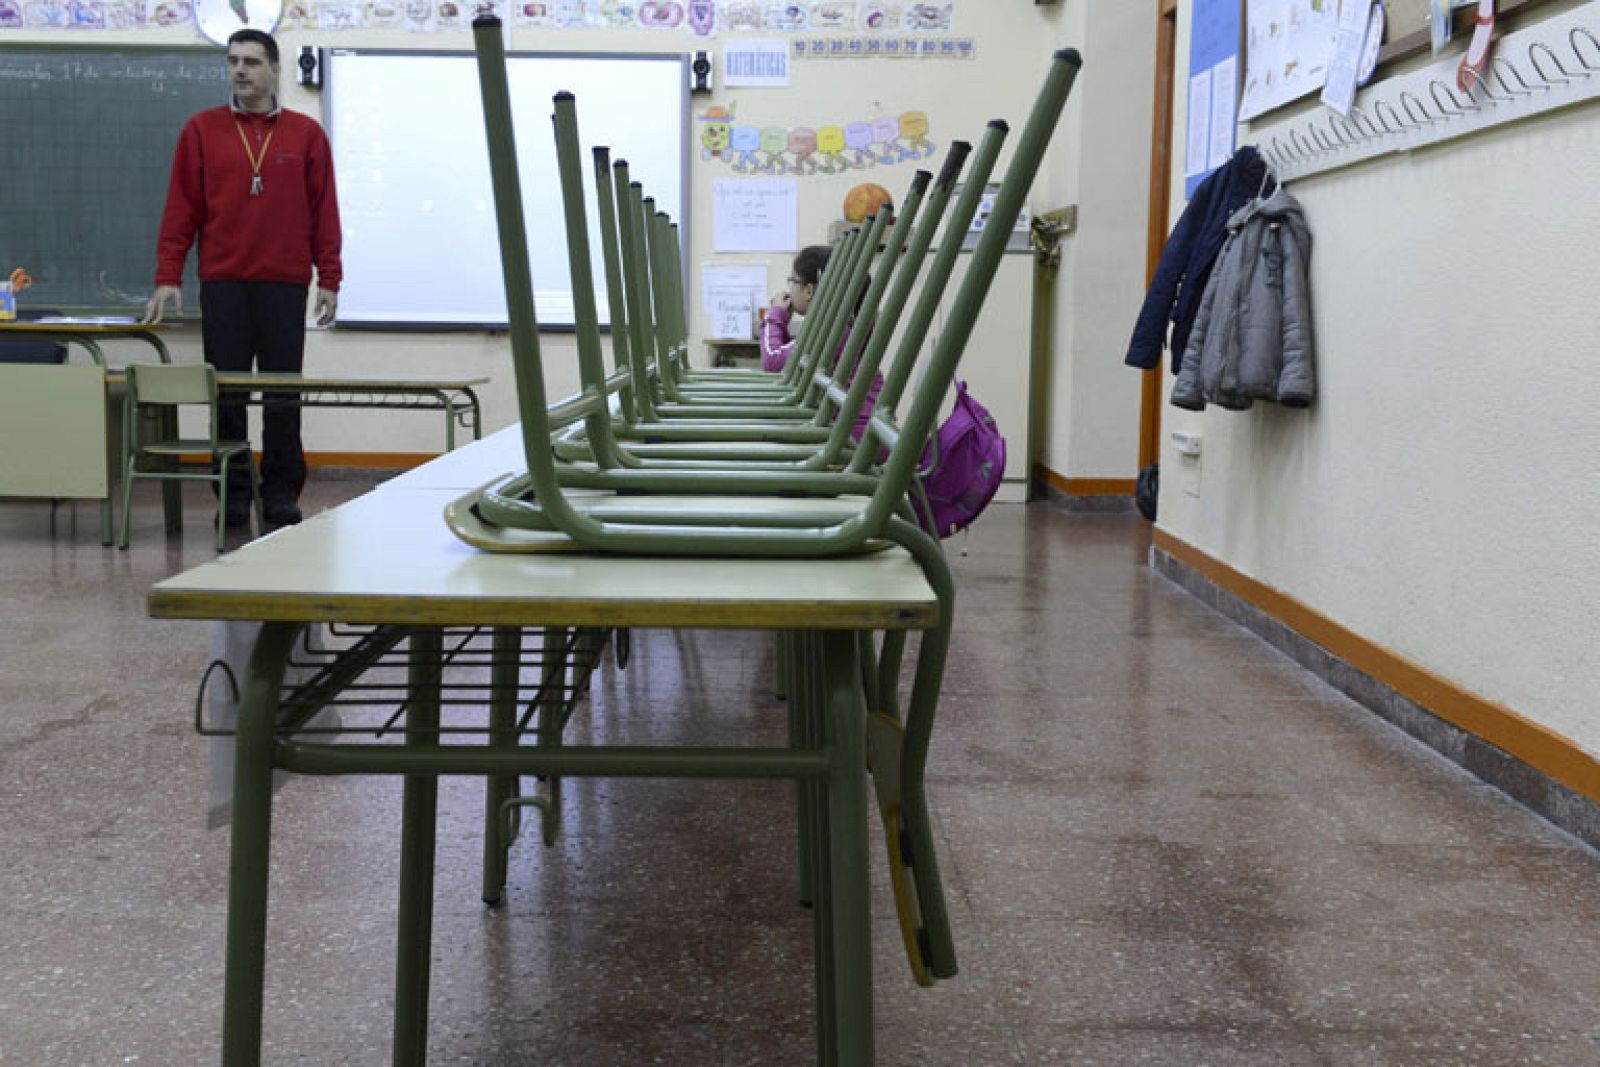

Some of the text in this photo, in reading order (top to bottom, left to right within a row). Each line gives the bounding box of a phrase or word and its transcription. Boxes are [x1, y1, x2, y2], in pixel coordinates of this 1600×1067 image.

[812, 40, 824, 52] 20
[831, 40, 844, 52] 30
[849, 40, 862, 52] 40
[886, 40, 899, 52] 60
[904, 40, 918, 52] 70
